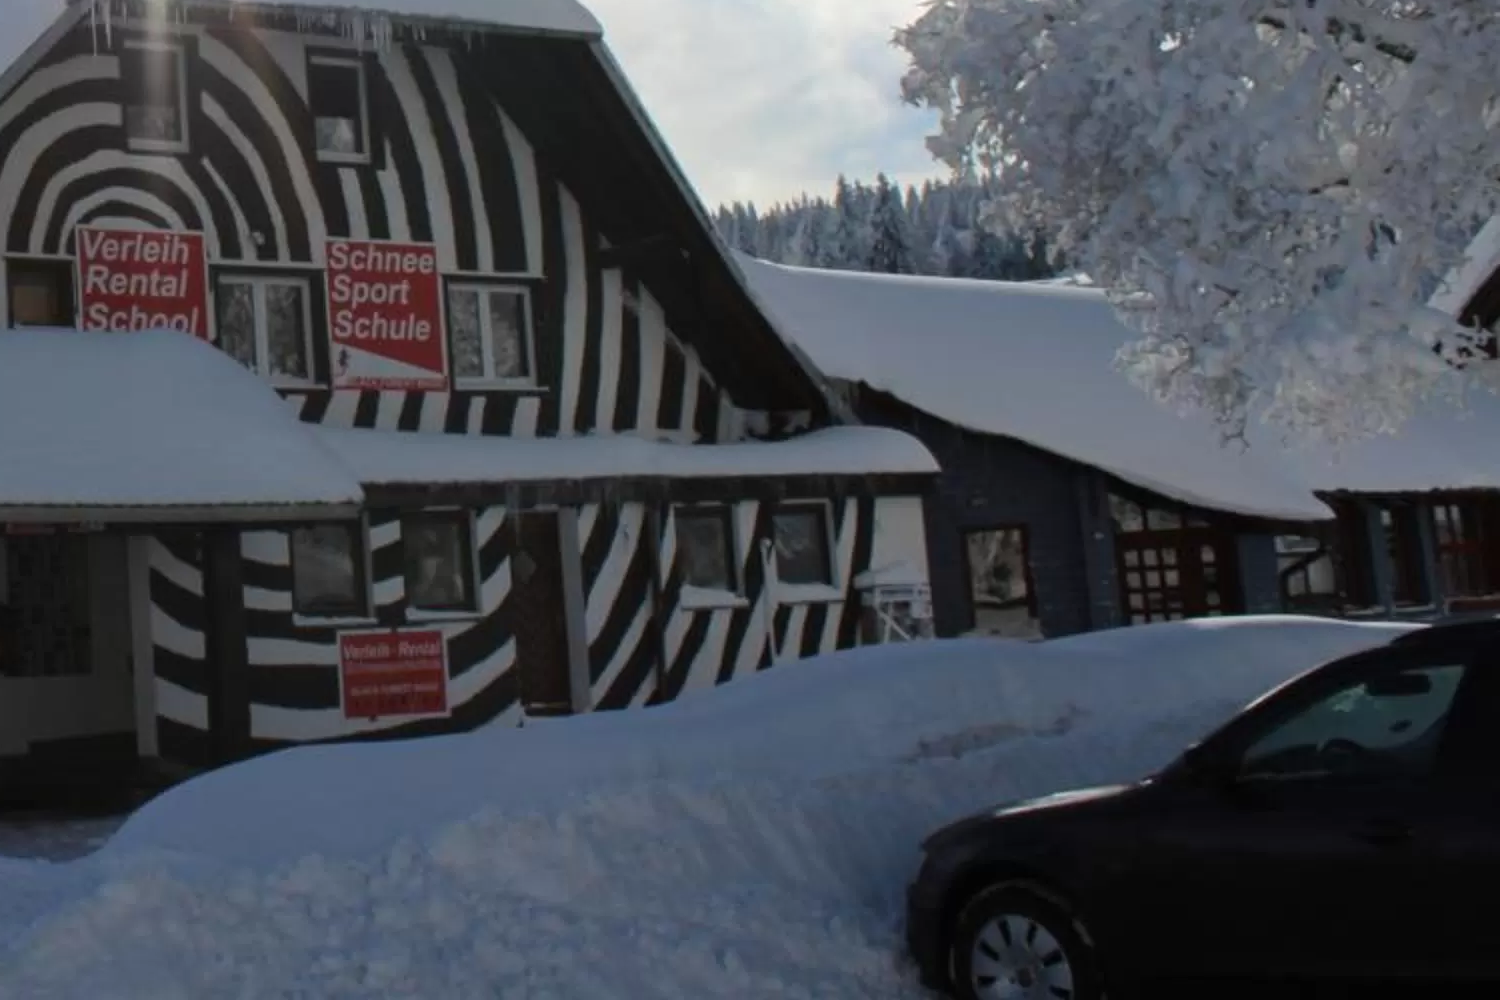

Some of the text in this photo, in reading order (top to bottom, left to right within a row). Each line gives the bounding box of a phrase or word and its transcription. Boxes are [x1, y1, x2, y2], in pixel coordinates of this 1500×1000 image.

[82, 230, 189, 265] Verleih
[328, 242, 434, 275] Schnee
[85, 264, 189, 298] Rental
[331, 273, 411, 310] Sport
[333, 309, 432, 342] Schule
